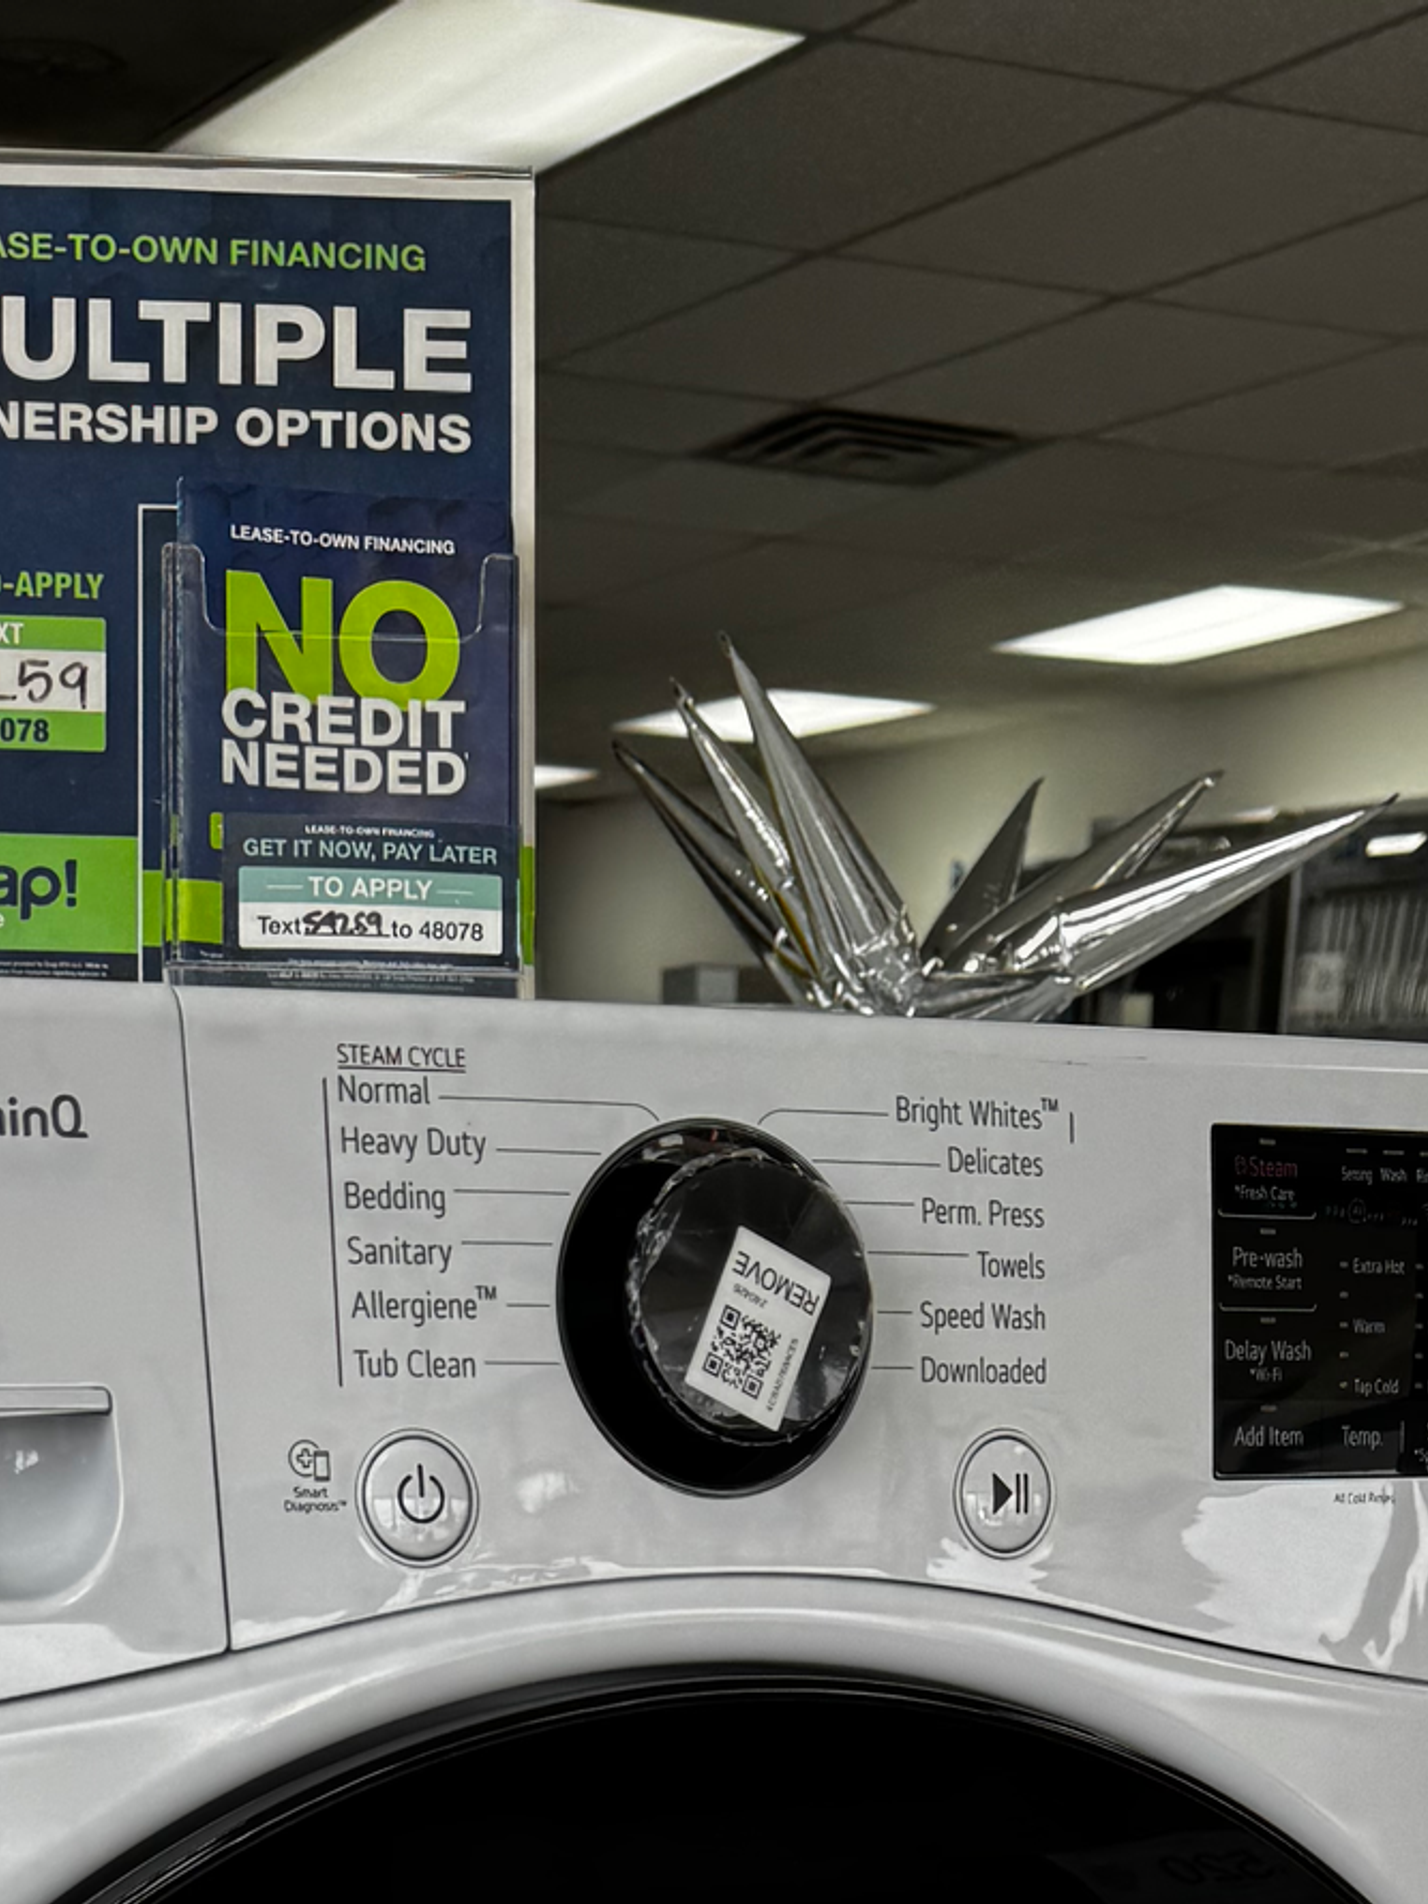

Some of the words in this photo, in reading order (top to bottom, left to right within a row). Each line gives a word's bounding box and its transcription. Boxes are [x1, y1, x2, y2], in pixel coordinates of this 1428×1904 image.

[229, 238, 427, 272] FINANCING
[235, 406, 472, 454] OPTIONS
[230, 524, 360, 550] LEASE-TO-OWN
[363, 535, 455, 556] FINANCING
[225, 569, 461, 712] NO
[221, 686, 467, 749] CREDIT
[242, 837, 288, 858] GET
[292, 839, 317, 859] IT
[319, 840, 377, 863] NOW,
[382, 842, 422, 862] PAY
[428, 844, 498, 866] LATER
[307, 875, 345, 898] TO
[350, 877, 433, 901] APPLY
[257, 914, 302, 936] Text
[391, 919, 414, 939] to
[418, 920, 485, 942] 48078
[336, 1042, 403, 1066] STEAM
[407, 1046, 467, 1069] CYCLE
[336, 1073, 431, 1105] Normal
[895, 1094, 963, 1133] Bright
[339, 1125, 419, 1164] Heavy
[426, 1126, 487, 1165] Duty
[947, 1145, 1044, 1178] Delicates
[1248, 1155, 1299, 1178] Steam
[343, 1180, 447, 1220] Bedding
[921, 1196, 982, 1227] Perm.
[988, 1199, 1045, 1229] Press
[346, 1235, 453, 1274] Sanitary
[976, 1249, 1046, 1280] Towels
[1352, 1257, 1383, 1275] Extra
[1384, 1258, 1405, 1275] Hot
[732, 1250, 820, 1316] REMOVE
[1275, 1275, 1303, 1291] Start
[919, 1299, 985, 1336] Speed
[991, 1302, 1046, 1331] Wash
[1353, 1318, 1386, 1335] Warm
[352, 1347, 400, 1379] Tub
[406, 1348, 477, 1379] Clean
[1224, 1339, 1268, 1366] Delay
[1271, 1340, 1313, 1362] Wash
[920, 1355, 1048, 1385] Downloaded
[1353, 1378, 1373, 1397] Tap
[1373, 1378, 1400, 1395] Cold
[1232, 1425, 1265, 1447] Add
[1268, 1425, 1305, 1447] Item
[1341, 1424, 1384, 1450] Temp.
[292, 1485, 329, 1499] Smart
